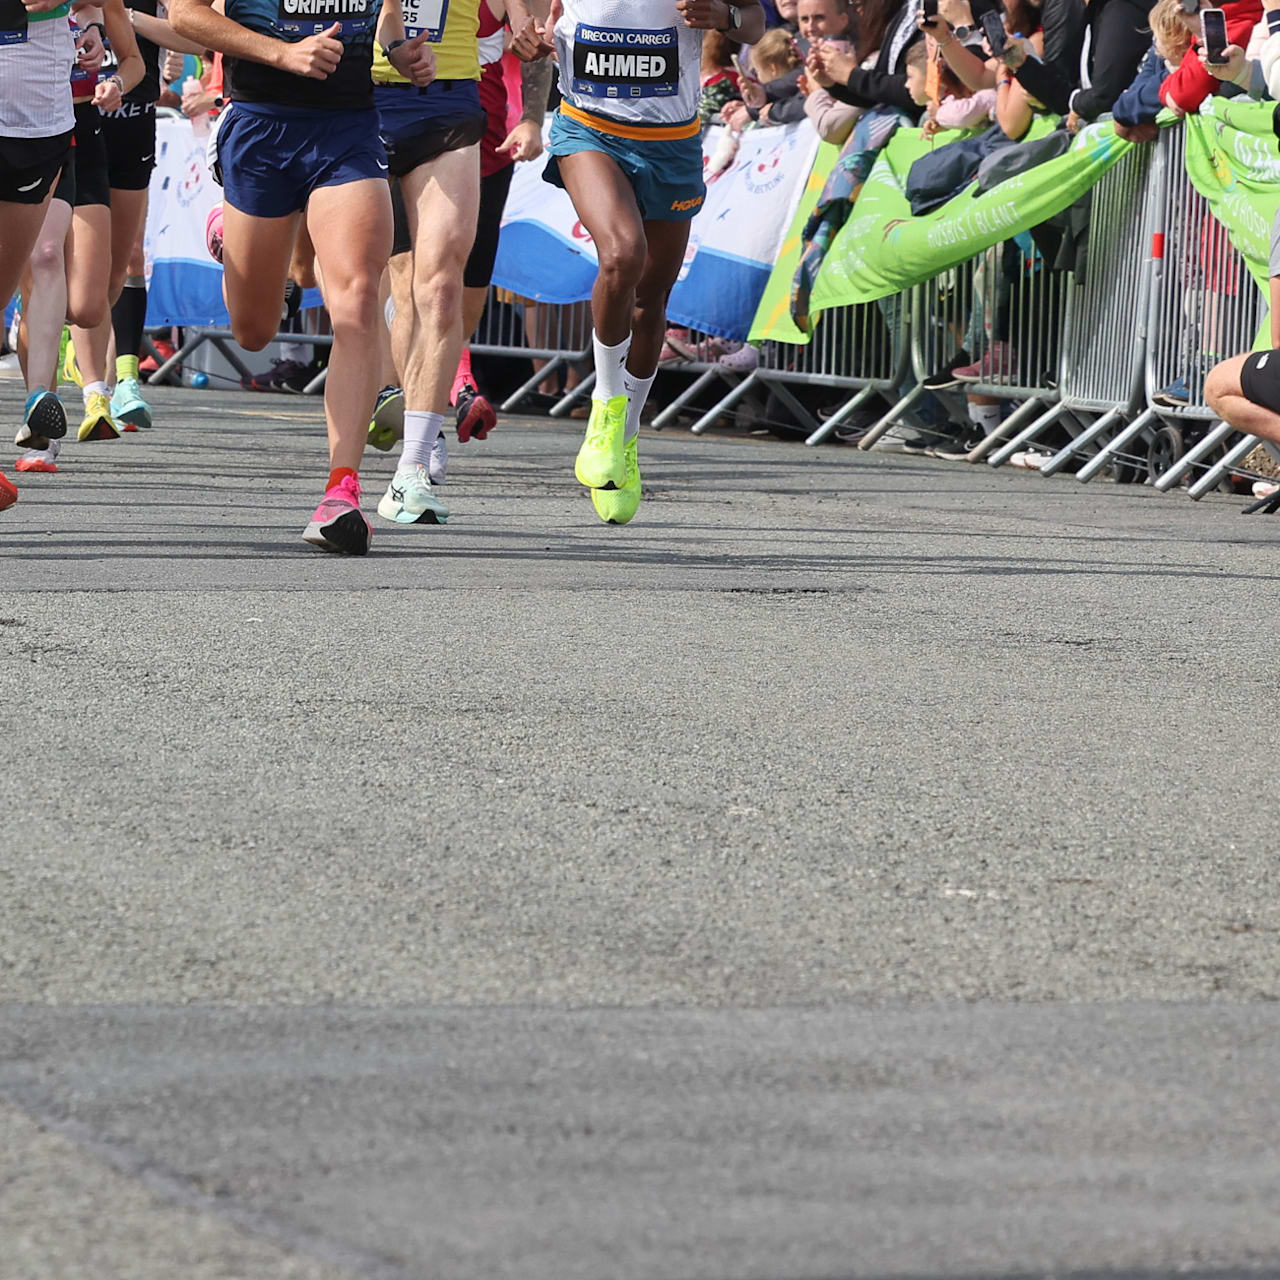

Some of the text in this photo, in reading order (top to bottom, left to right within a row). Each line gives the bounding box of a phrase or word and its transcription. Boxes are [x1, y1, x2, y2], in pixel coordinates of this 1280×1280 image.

[581, 28, 672, 46] BRECON CARREG
[584, 51, 667, 78] AHMED
[977, 202, 1023, 236] BLANT
